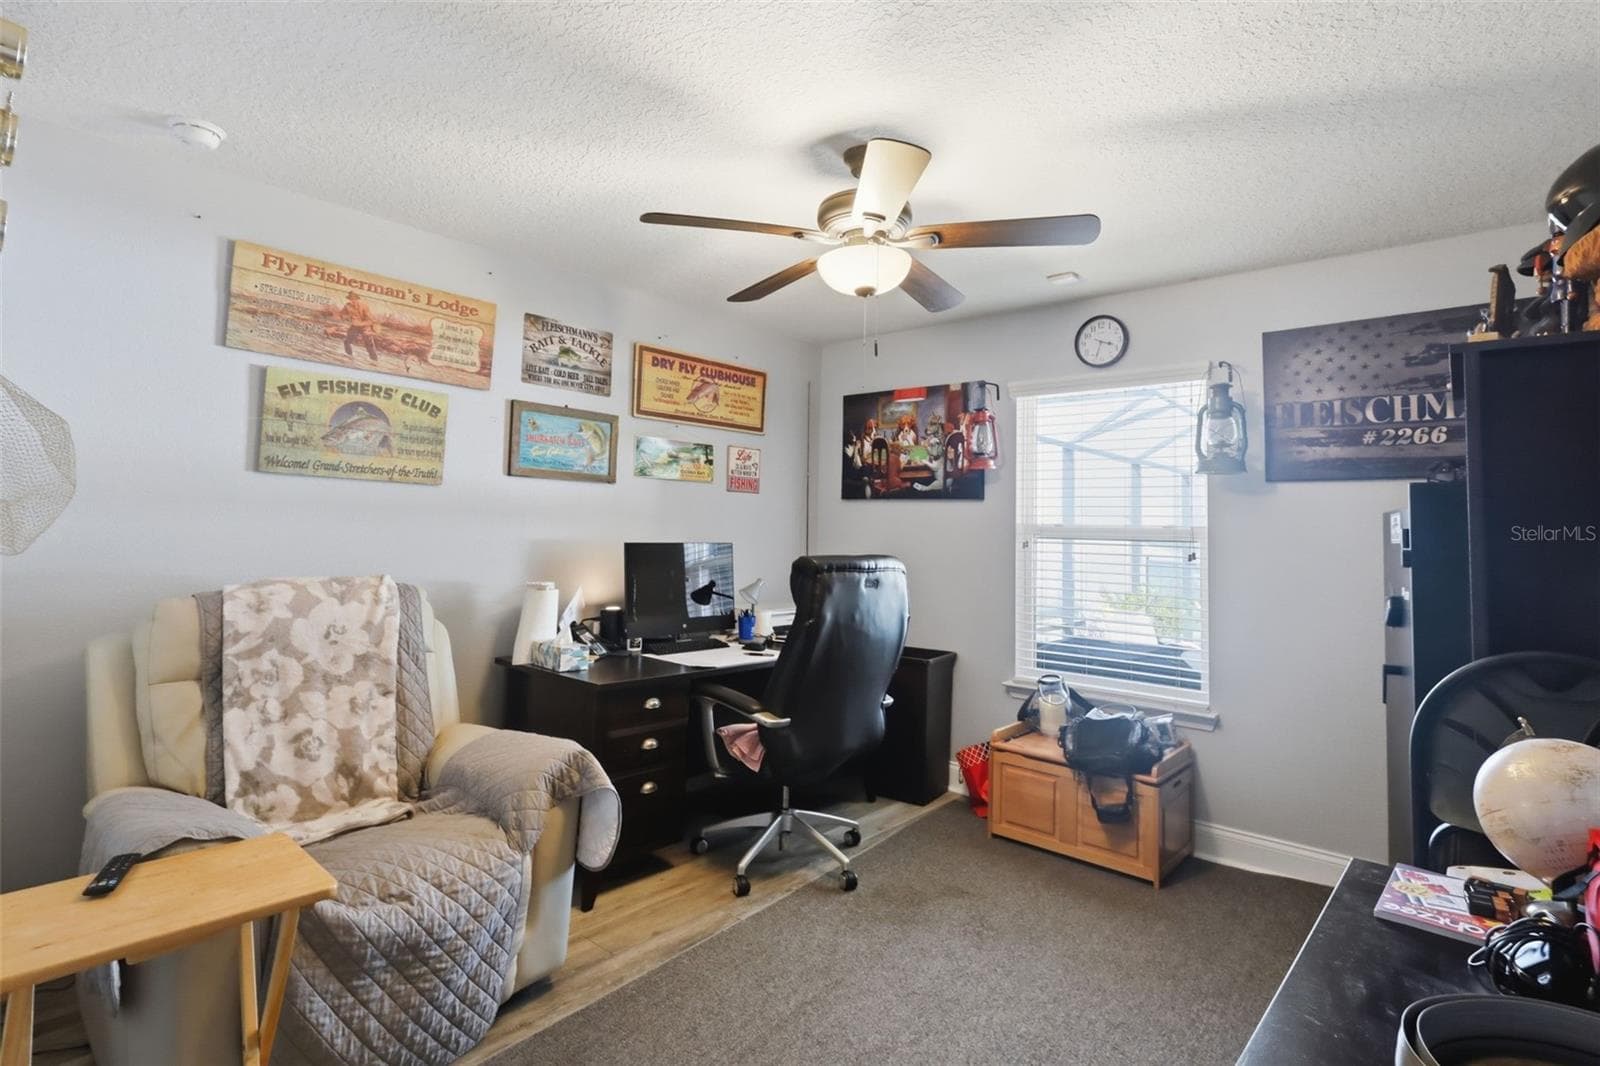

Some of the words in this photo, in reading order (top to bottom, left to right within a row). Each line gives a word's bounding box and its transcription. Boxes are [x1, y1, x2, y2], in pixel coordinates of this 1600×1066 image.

[261, 252, 298, 276] Fly
[303, 262, 421, 303] Fisherman's
[425, 292, 479, 317] Lodge
[529, 335, 555, 353] BAIT
[571, 337, 608, 368] TACKLE
[651, 355, 676, 371] DRY
[678, 361, 697, 375] FLY
[699, 366, 756, 387] CLUBHOUSE
[277, 381, 311, 400] FLY
[317, 380, 399, 400] FISHERS'
[400, 392, 442, 419] CLUB
[1274, 393, 1465, 427] FLEISCHM
[1362, 426, 1448, 445] #2266
[264, 455, 309, 470] Welcome!
[735, 449, 753, 464] Life
[730, 476, 758, 491] FISHING
